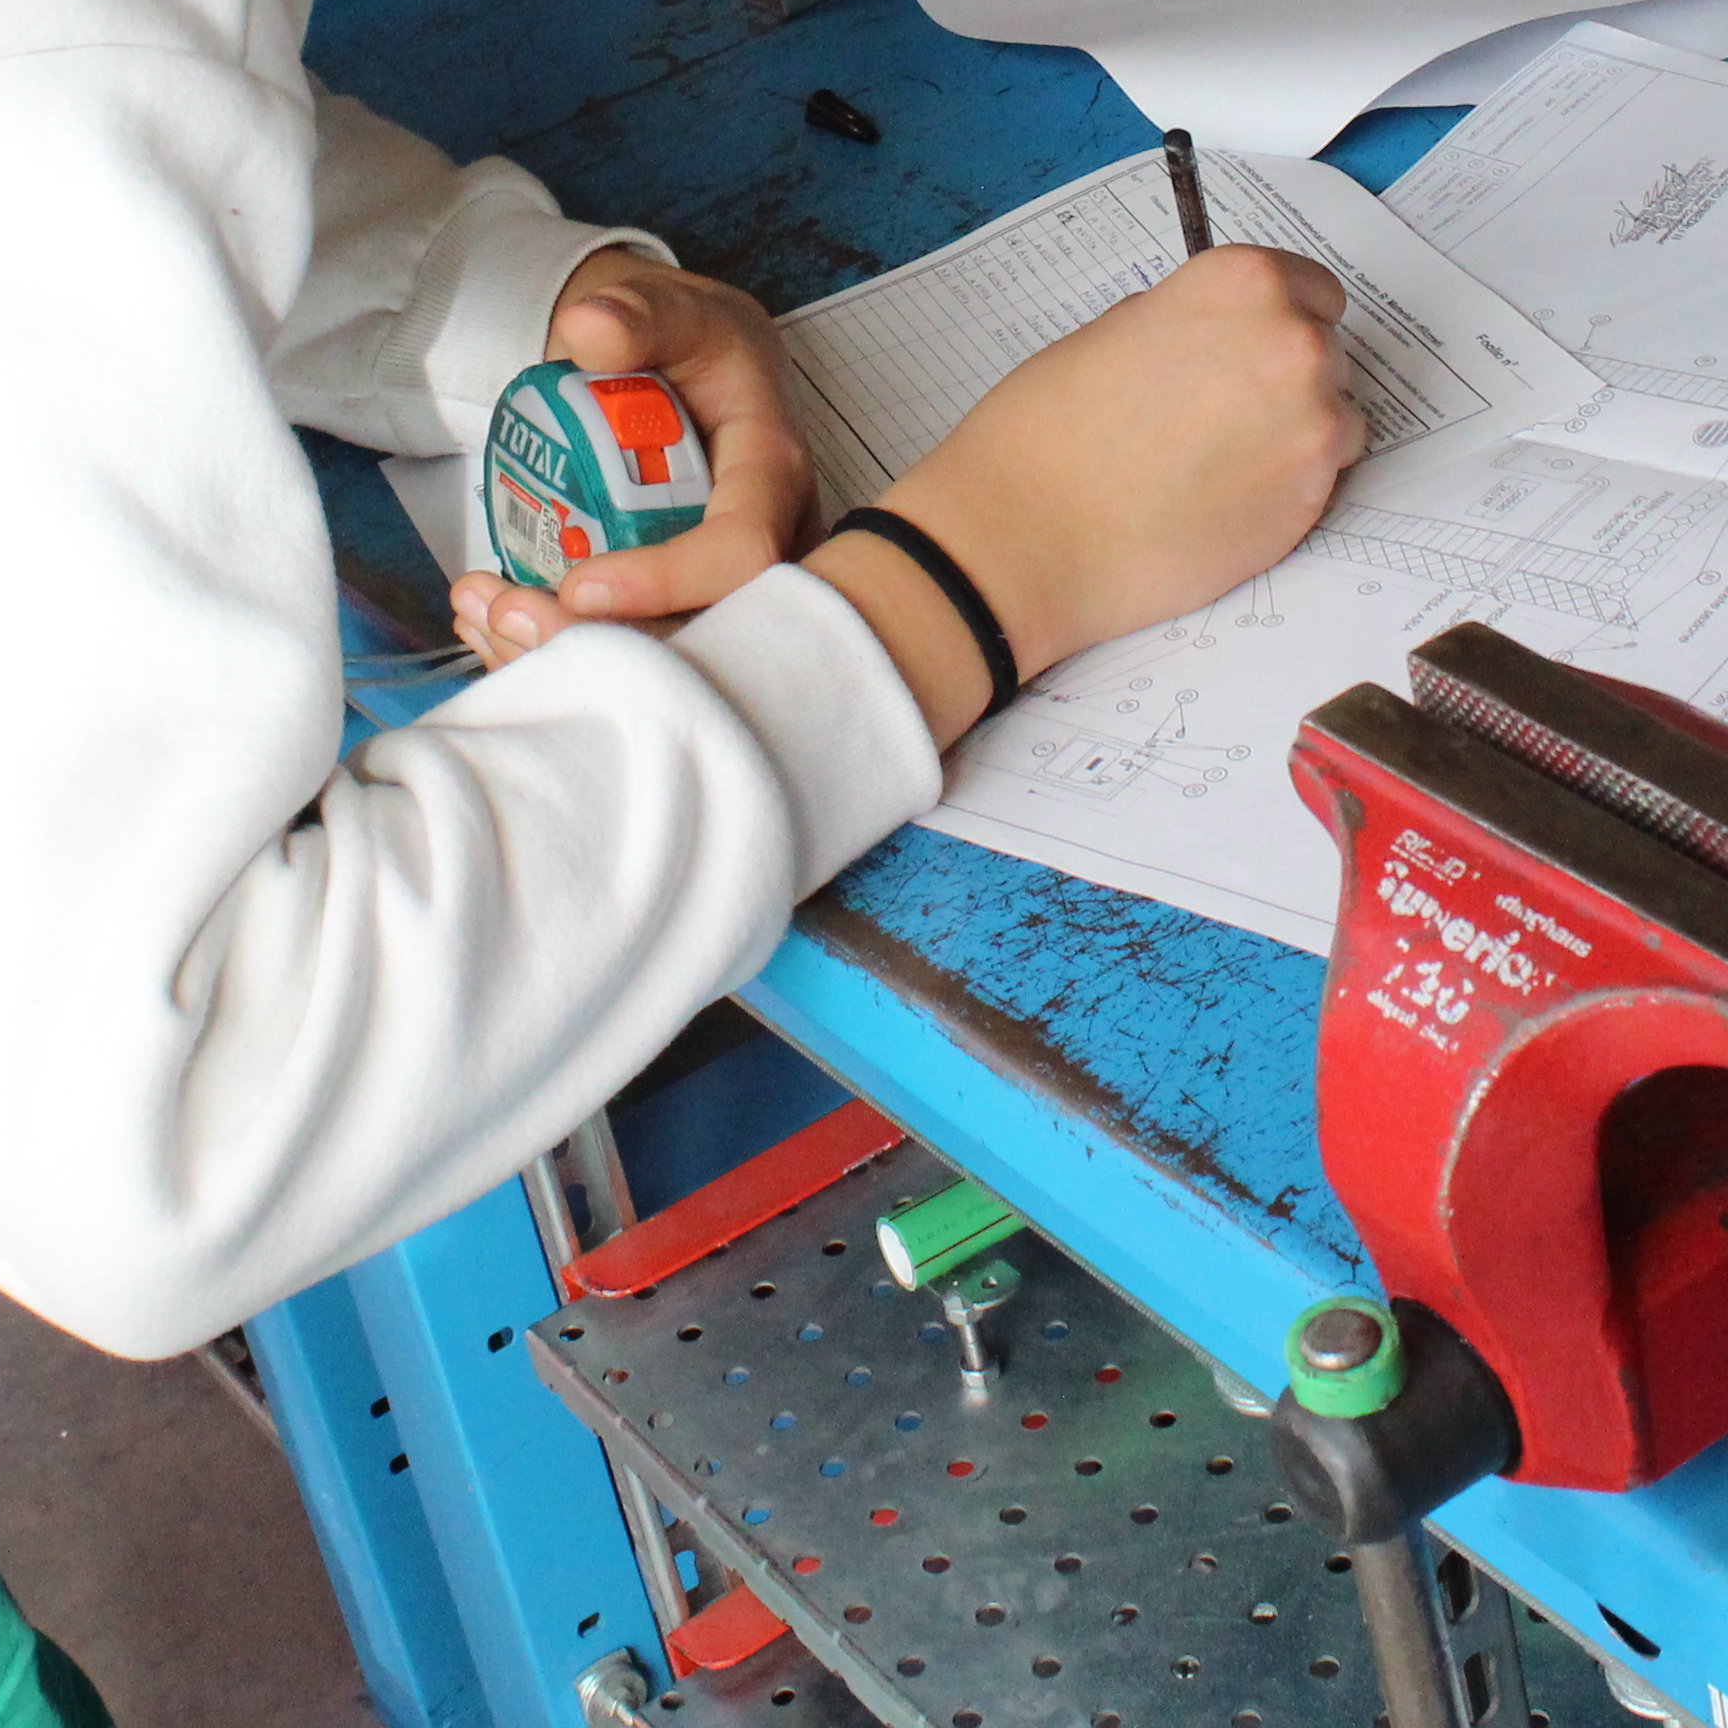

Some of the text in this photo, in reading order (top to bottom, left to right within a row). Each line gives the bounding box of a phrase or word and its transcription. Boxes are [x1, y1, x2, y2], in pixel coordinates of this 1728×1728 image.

[1352, 271, 1385, 294] Quadro
[1472, 333, 1509, 359] Foglio
[497, 407, 570, 490] TOTAL
[1596, 519, 1643, 555] EDIFICIO
[1419, 588, 1455, 612] PRESA
[1675, 609, 1718, 644] sezione
